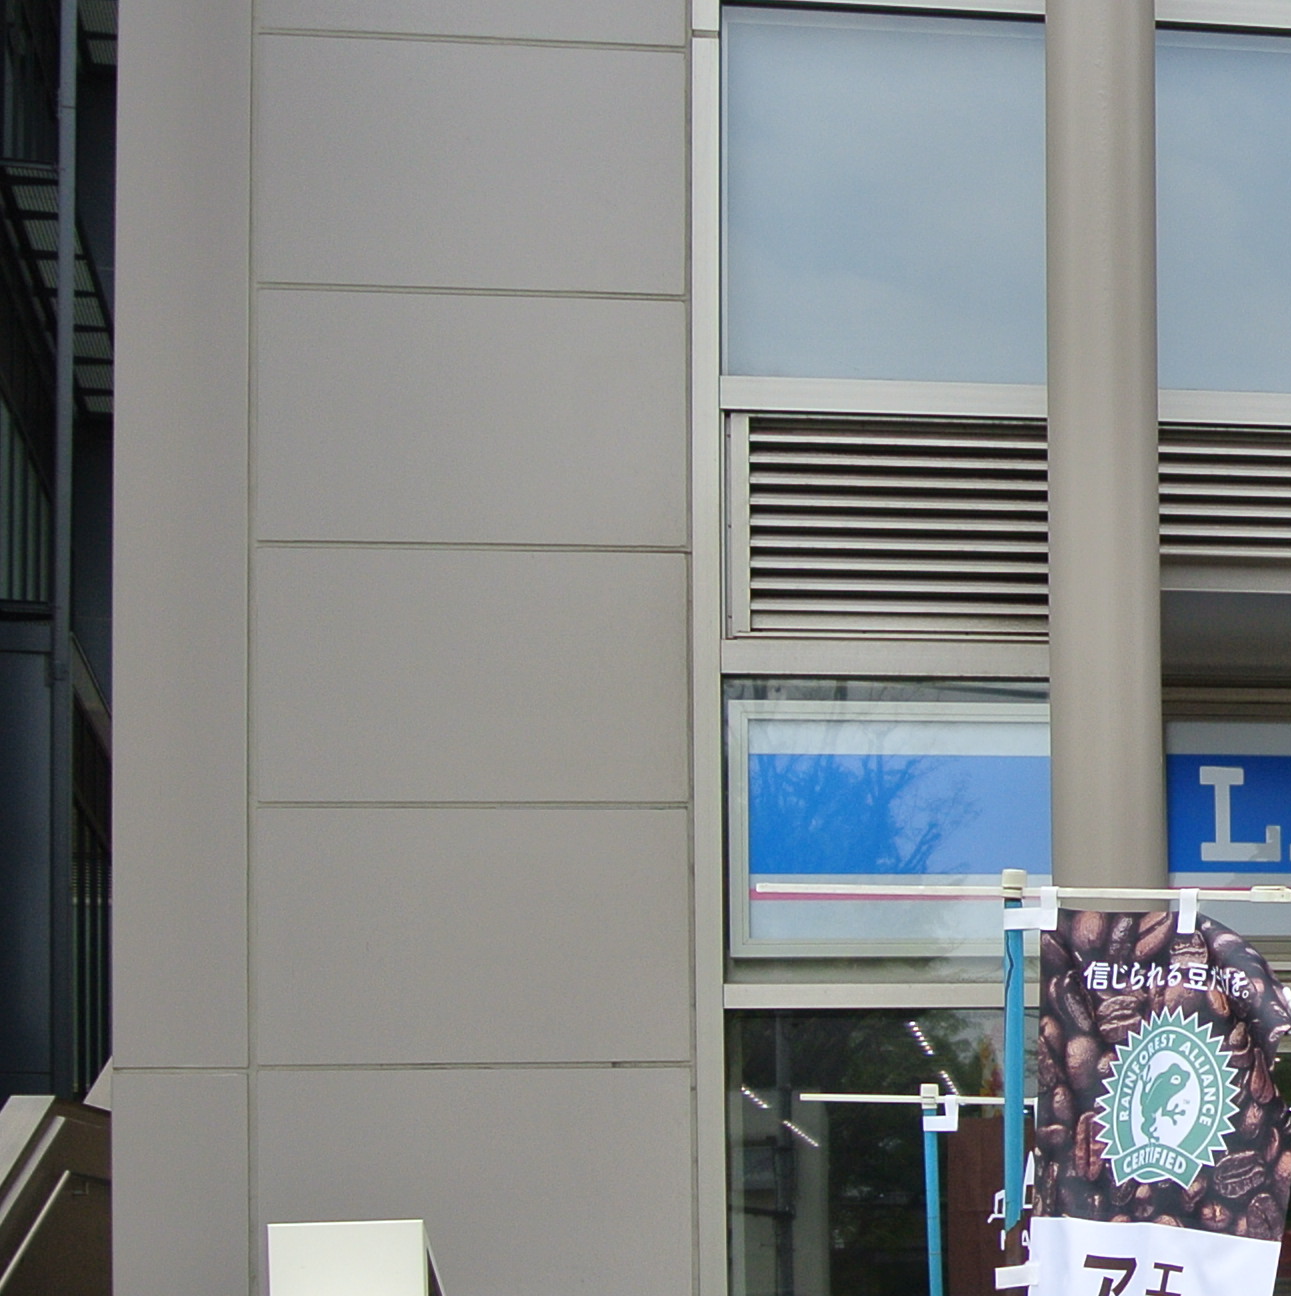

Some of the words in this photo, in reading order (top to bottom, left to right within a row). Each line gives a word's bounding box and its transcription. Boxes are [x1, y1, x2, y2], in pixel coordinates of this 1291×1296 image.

[1119, 1033, 1177, 1121] RAINFOREST
[1179, 1041, 1218, 1127] ALLIANCE
[1122, 1147, 1187, 1175] CERTIFIED
